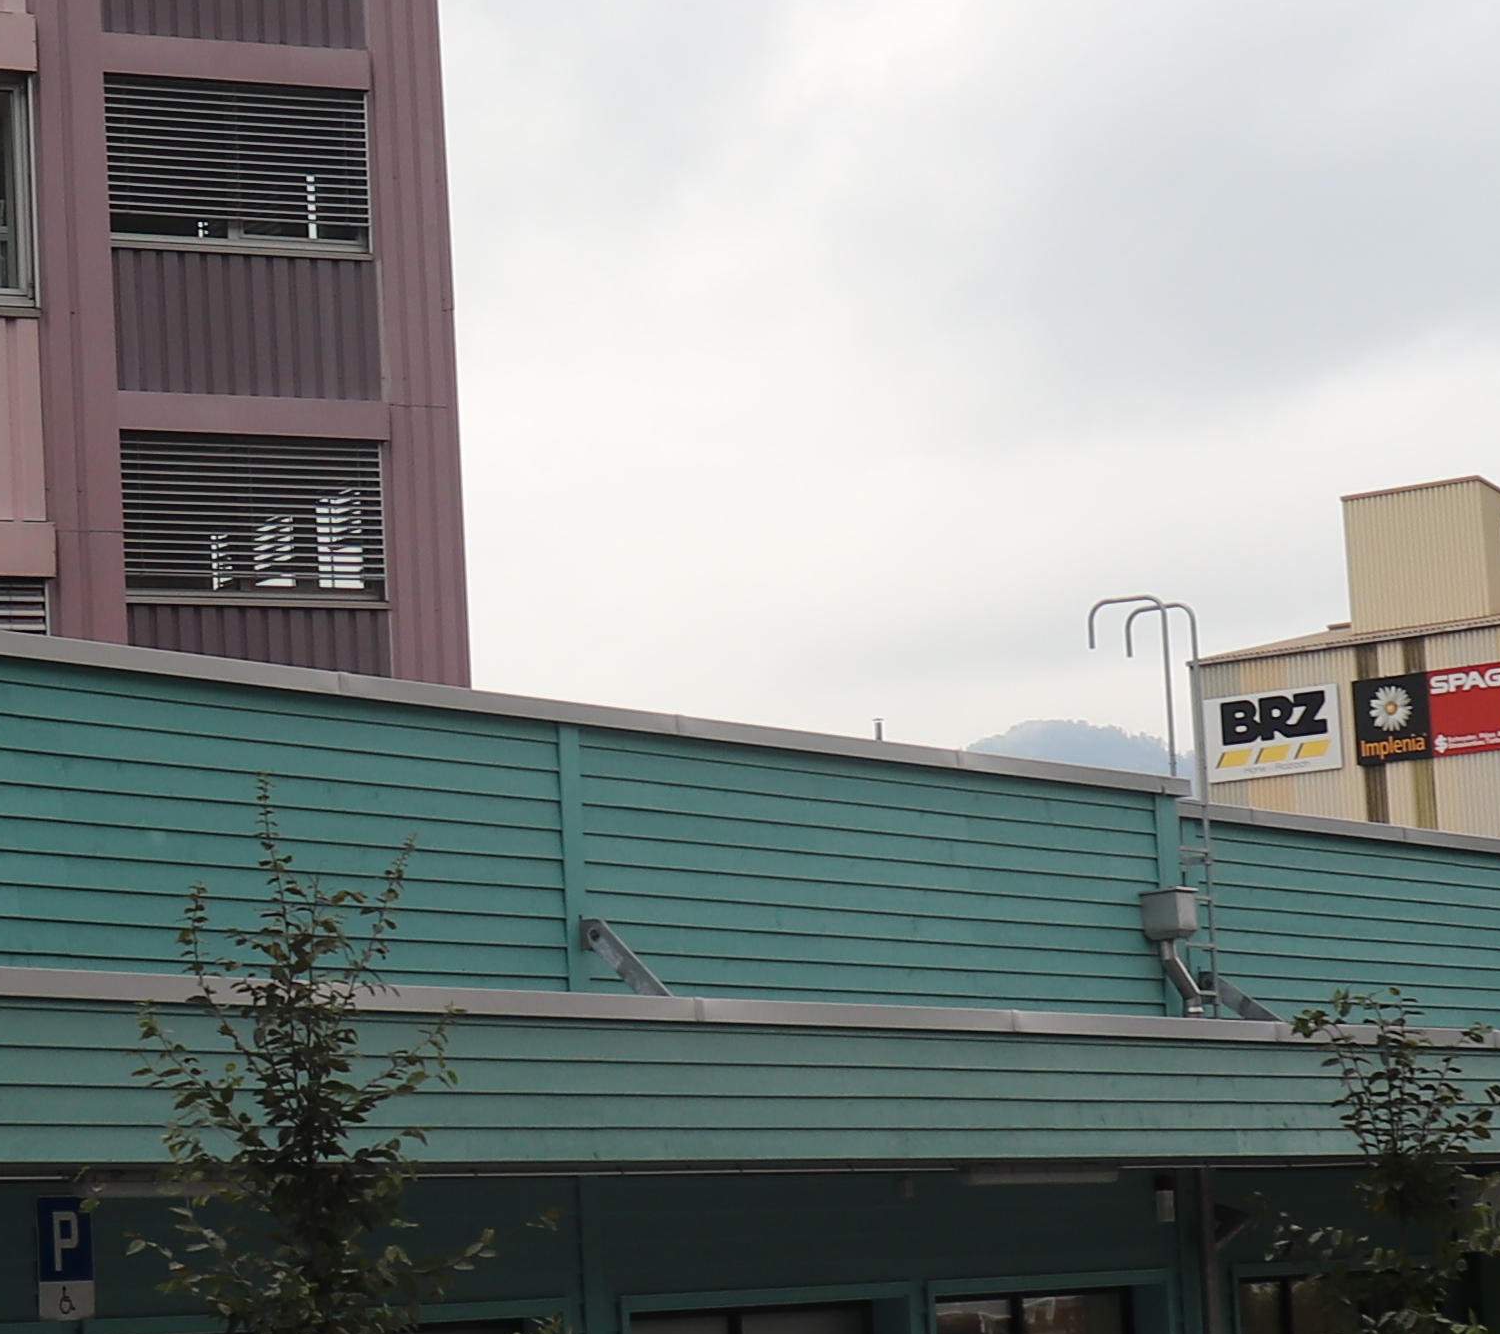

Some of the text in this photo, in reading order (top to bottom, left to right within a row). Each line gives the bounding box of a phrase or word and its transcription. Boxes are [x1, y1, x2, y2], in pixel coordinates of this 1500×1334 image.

[1220, 690, 1328, 746] BRZ
[1360, 734, 1425, 759] Implenia
[51, 1210, 79, 1272] P
